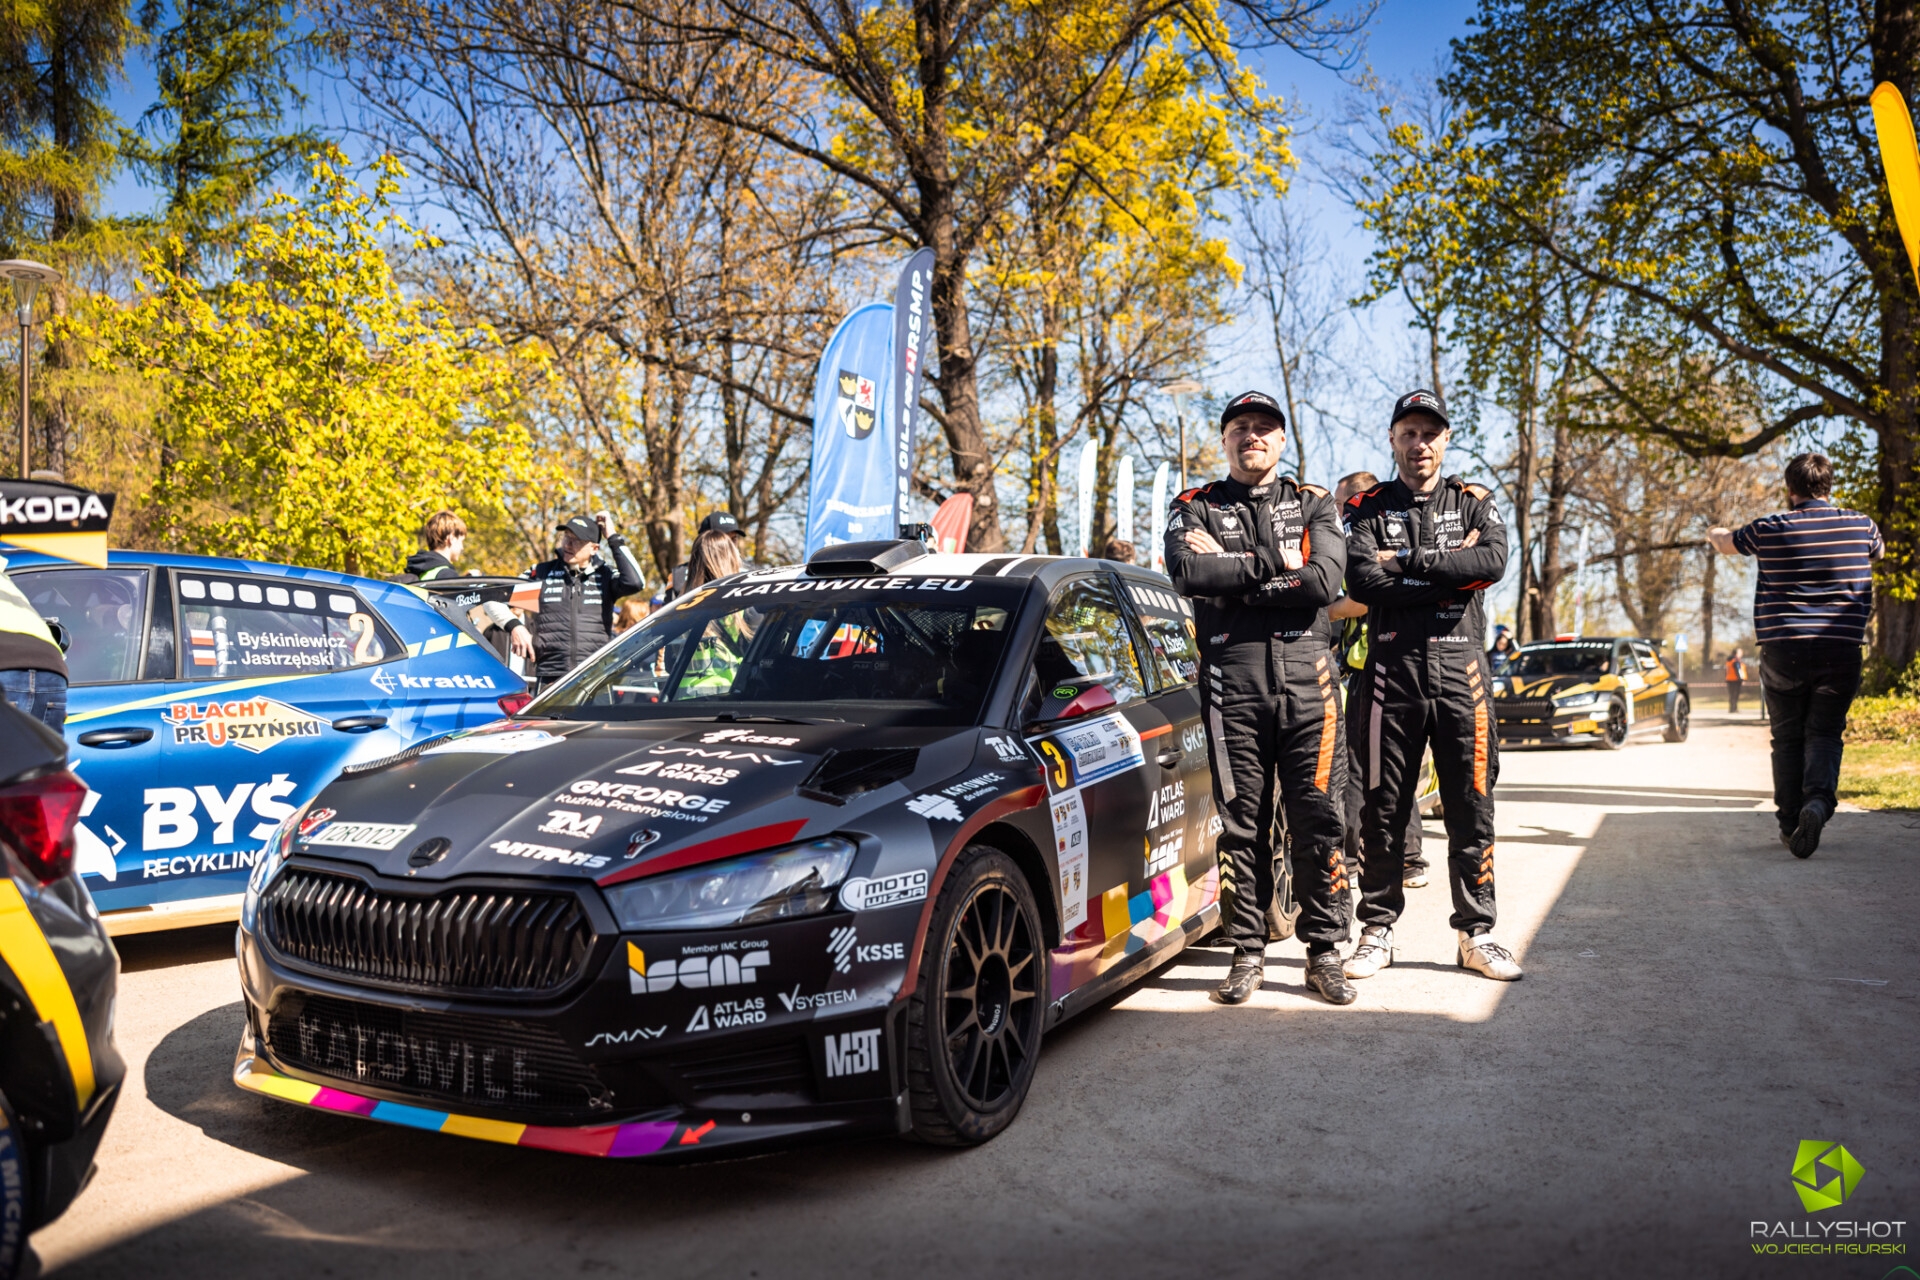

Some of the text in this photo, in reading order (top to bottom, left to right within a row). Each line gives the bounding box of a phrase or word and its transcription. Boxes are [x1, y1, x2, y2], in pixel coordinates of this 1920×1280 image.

[0, 494, 108, 524] KODA
[722, 577, 974, 599] KATOWICE.EU
[237, 632, 348, 649] Byśkiniewicz
[349, 613, 386, 664] 2
[241, 652, 335, 669] Jastrzębski
[398, 674, 496, 690] kratki
[173, 702, 268, 720] BLACHY
[175, 717, 320, 746] PRUSZYŃSKI
[731, 733, 800, 747] KSSE
[664, 762, 740, 779] ATLAS
[1041, 740, 1067, 789] 3
[656, 768, 729, 786] WARD
[554, 792, 606, 808] Kuźnia
[569, 780, 731, 814] GKFORGE
[1160, 780, 1185, 805] ATLAS
[143, 773, 299, 852] BYŚ
[1160, 800, 1185, 825] WARD
[865, 872, 927, 892] MOTO
[866, 887, 927, 907] WIZJA
[682, 940, 768, 955] Member IMC Group
[857, 942, 905, 962] KSSE
[713, 997, 765, 1016] ATLAS
[714, 1010, 767, 1028] WARD
[299, 1012, 541, 1100] KATOWICE
